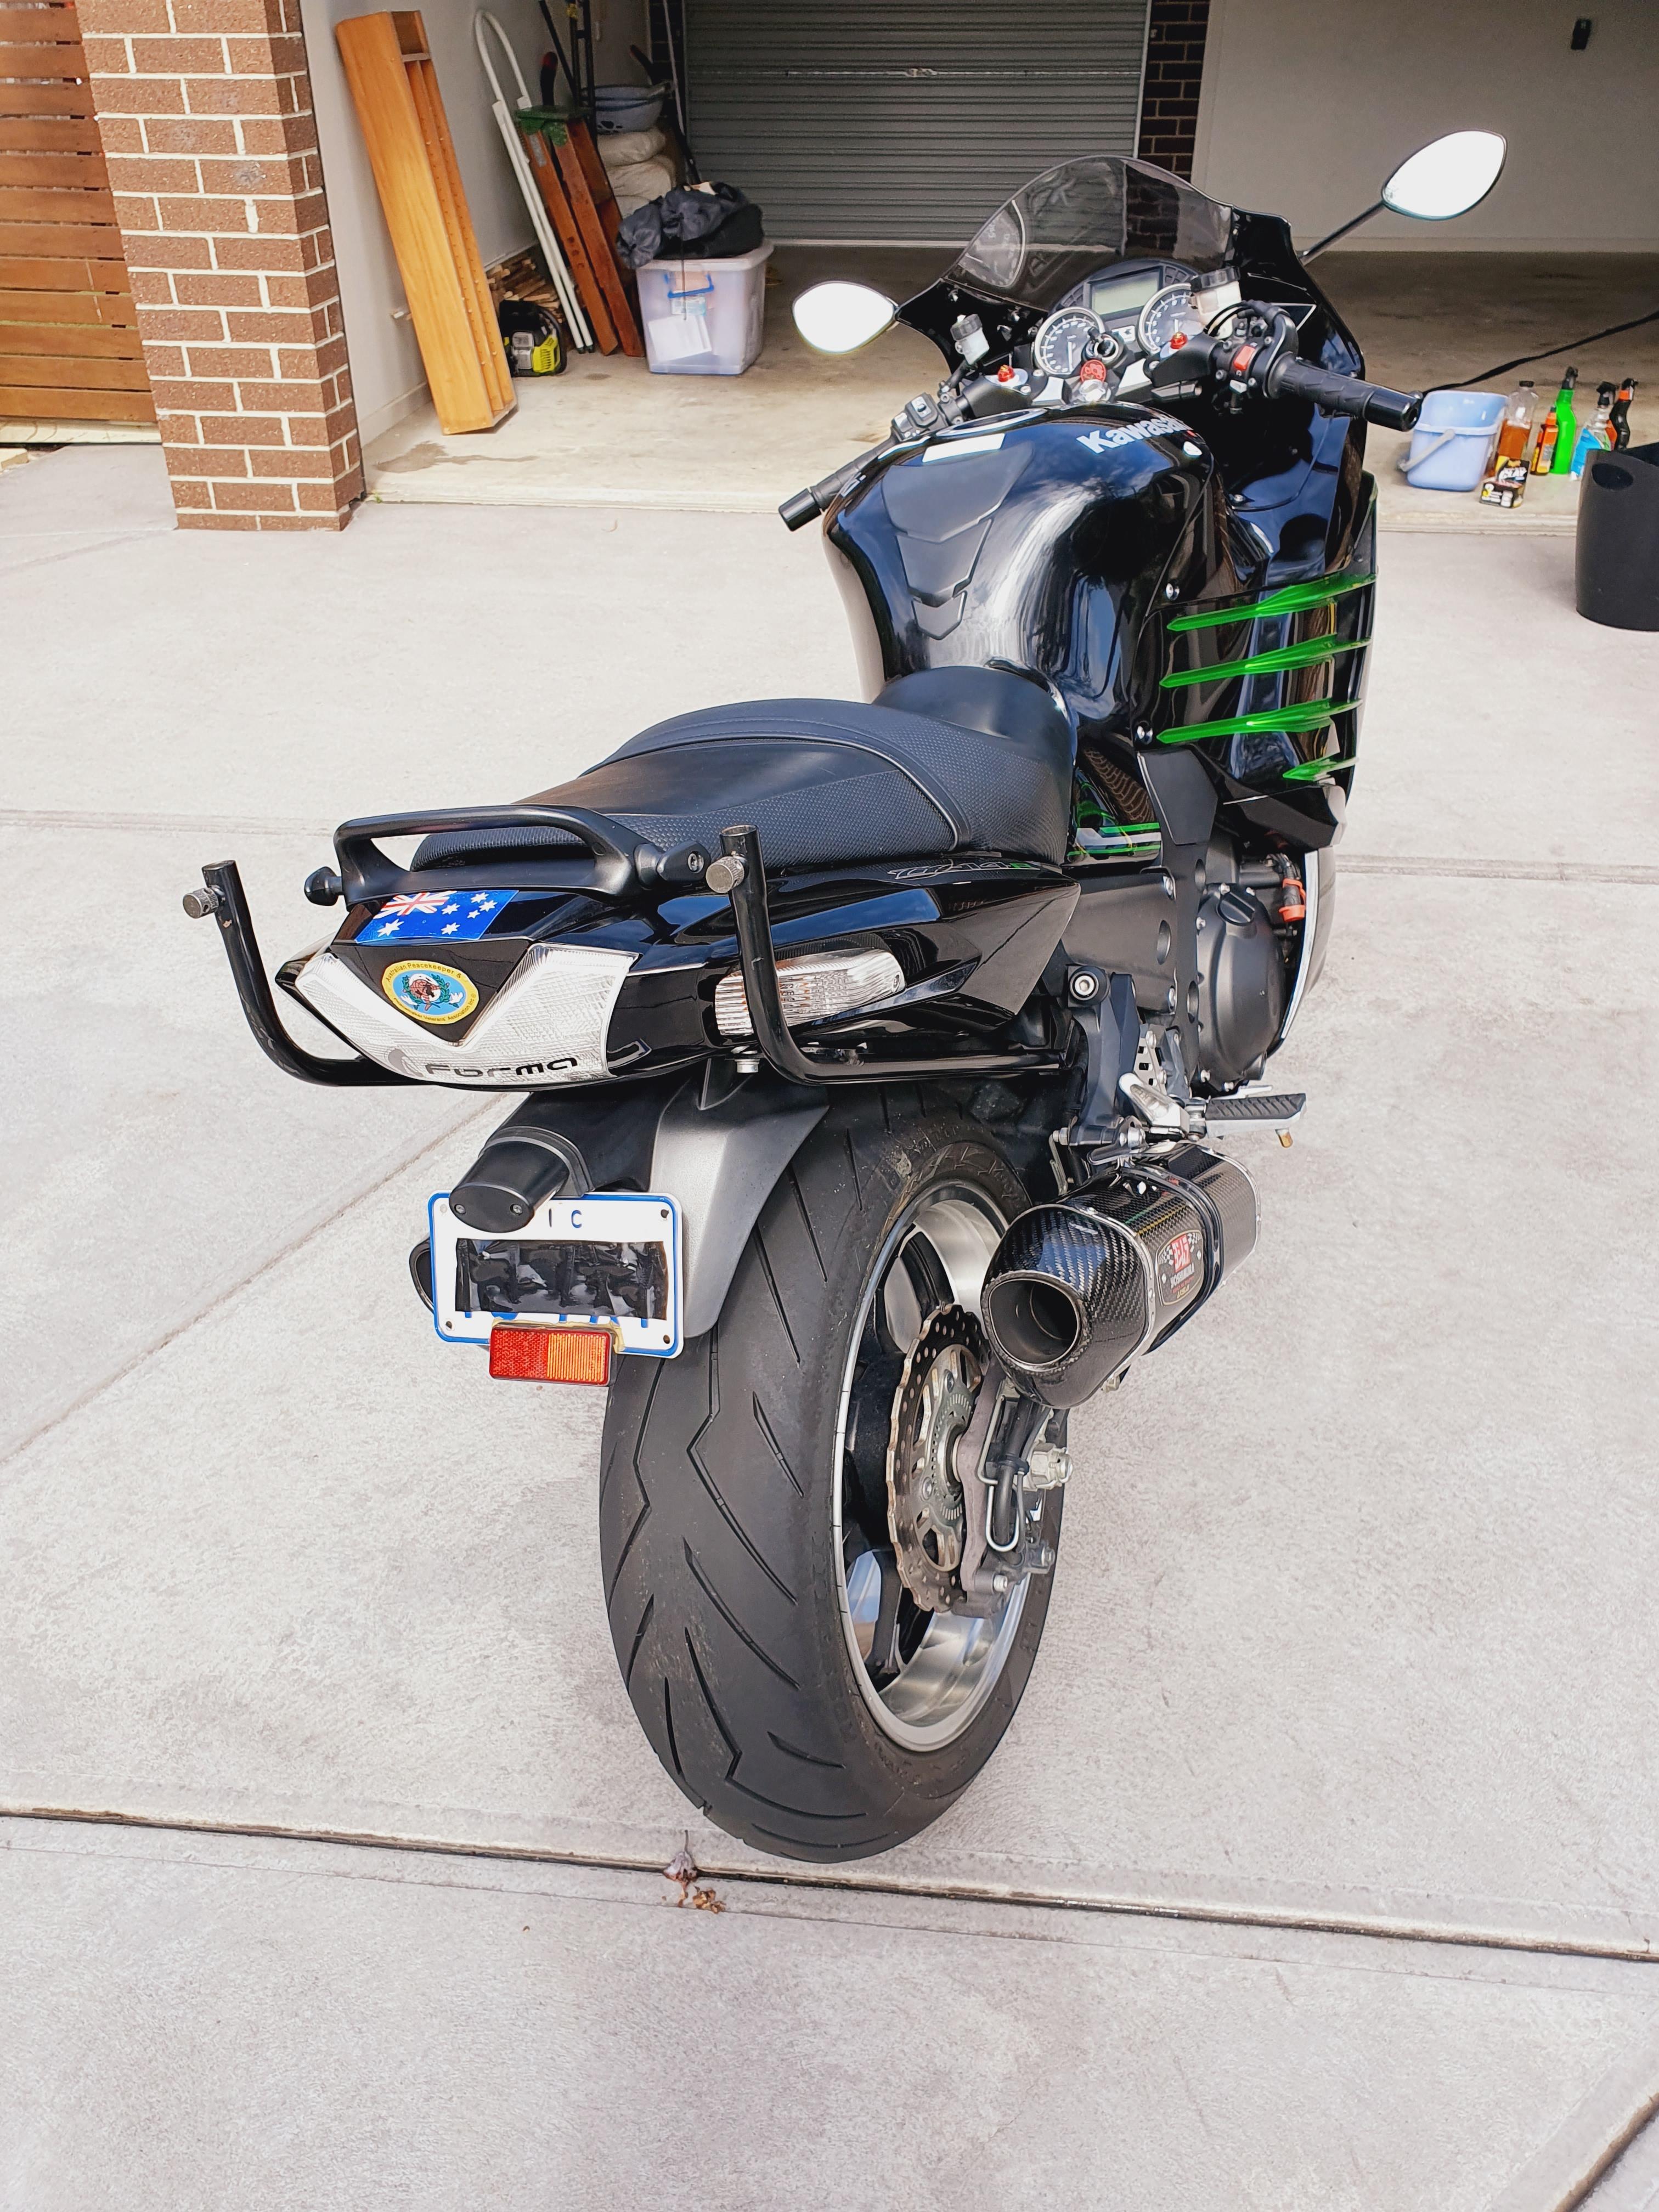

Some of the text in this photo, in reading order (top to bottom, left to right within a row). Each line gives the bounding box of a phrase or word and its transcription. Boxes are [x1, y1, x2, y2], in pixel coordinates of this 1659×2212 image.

[386, 964, 407, 983] Australian
[407, 963, 455, 974] Peacekeeper
[447, 1005, 471, 1020] Association
